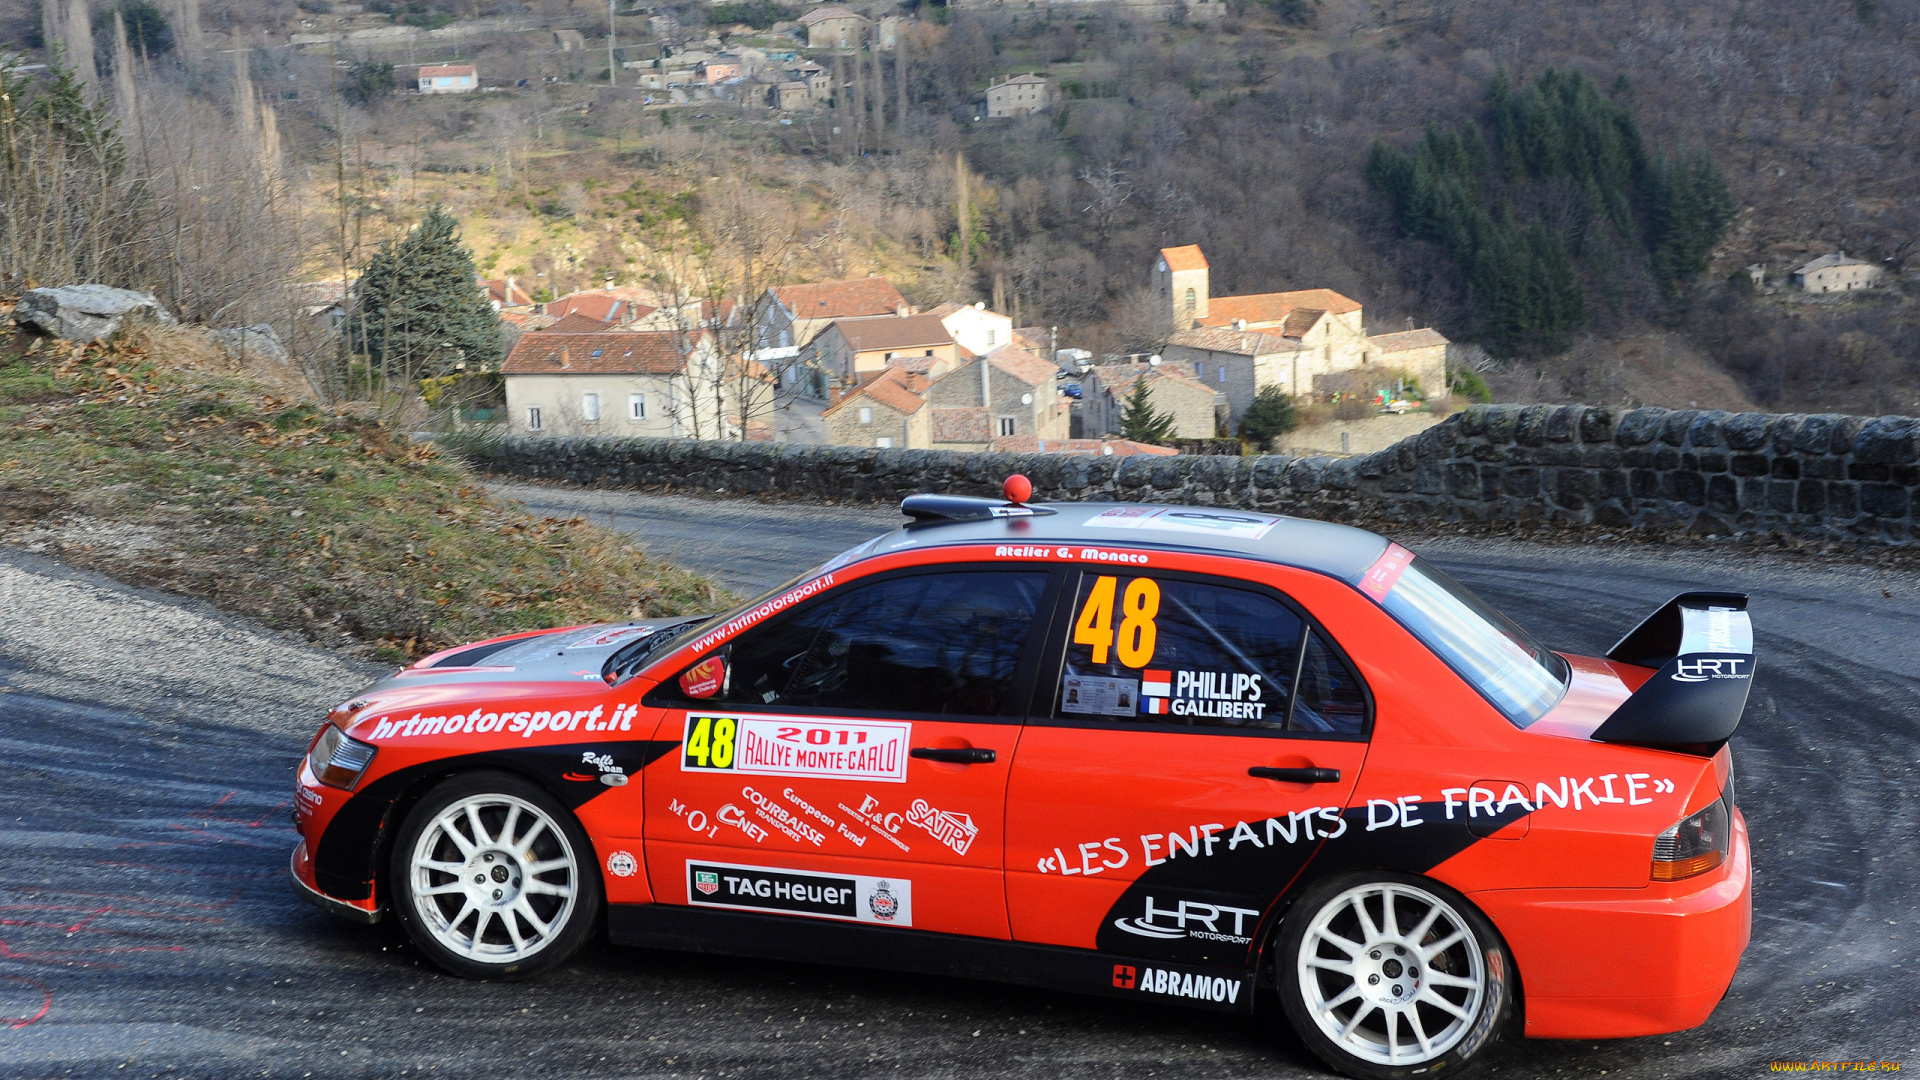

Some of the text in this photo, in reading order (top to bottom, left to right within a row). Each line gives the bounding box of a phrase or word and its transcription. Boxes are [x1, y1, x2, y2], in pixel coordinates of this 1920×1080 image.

[995, 546, 1149, 564] Atelier G. Monaco
[692, 574, 834, 653] www.hrtmotorsport.it
[1073, 575, 1161, 669] 48
[1677, 659, 1746, 675] HRT
[1176, 670, 1262, 702] PHILLIPS
[367, 703, 638, 740] hrtmotorsport.it
[1171, 699, 1267, 720] GALLIBERT
[687, 717, 736, 768] 48
[745, 730, 897, 772] RALLYE MONTE-CARLO
[776, 727, 868, 745] 2011
[598, 763, 624, 774] Team
[741, 786, 826, 847] COURBAISSE
[755, 807, 802, 842] TRANSPORTS
[782, 787, 867, 848] European Fund
[857, 793, 905, 835] E&G
[1140, 806, 1347, 867] ENFANTS
[1365, 795, 1424, 832] DE
[1145, 896, 1260, 936] HRT
[1189, 930, 1253, 945] MOTORSPORT
[1140, 967, 1241, 1004] ABRAMOV
